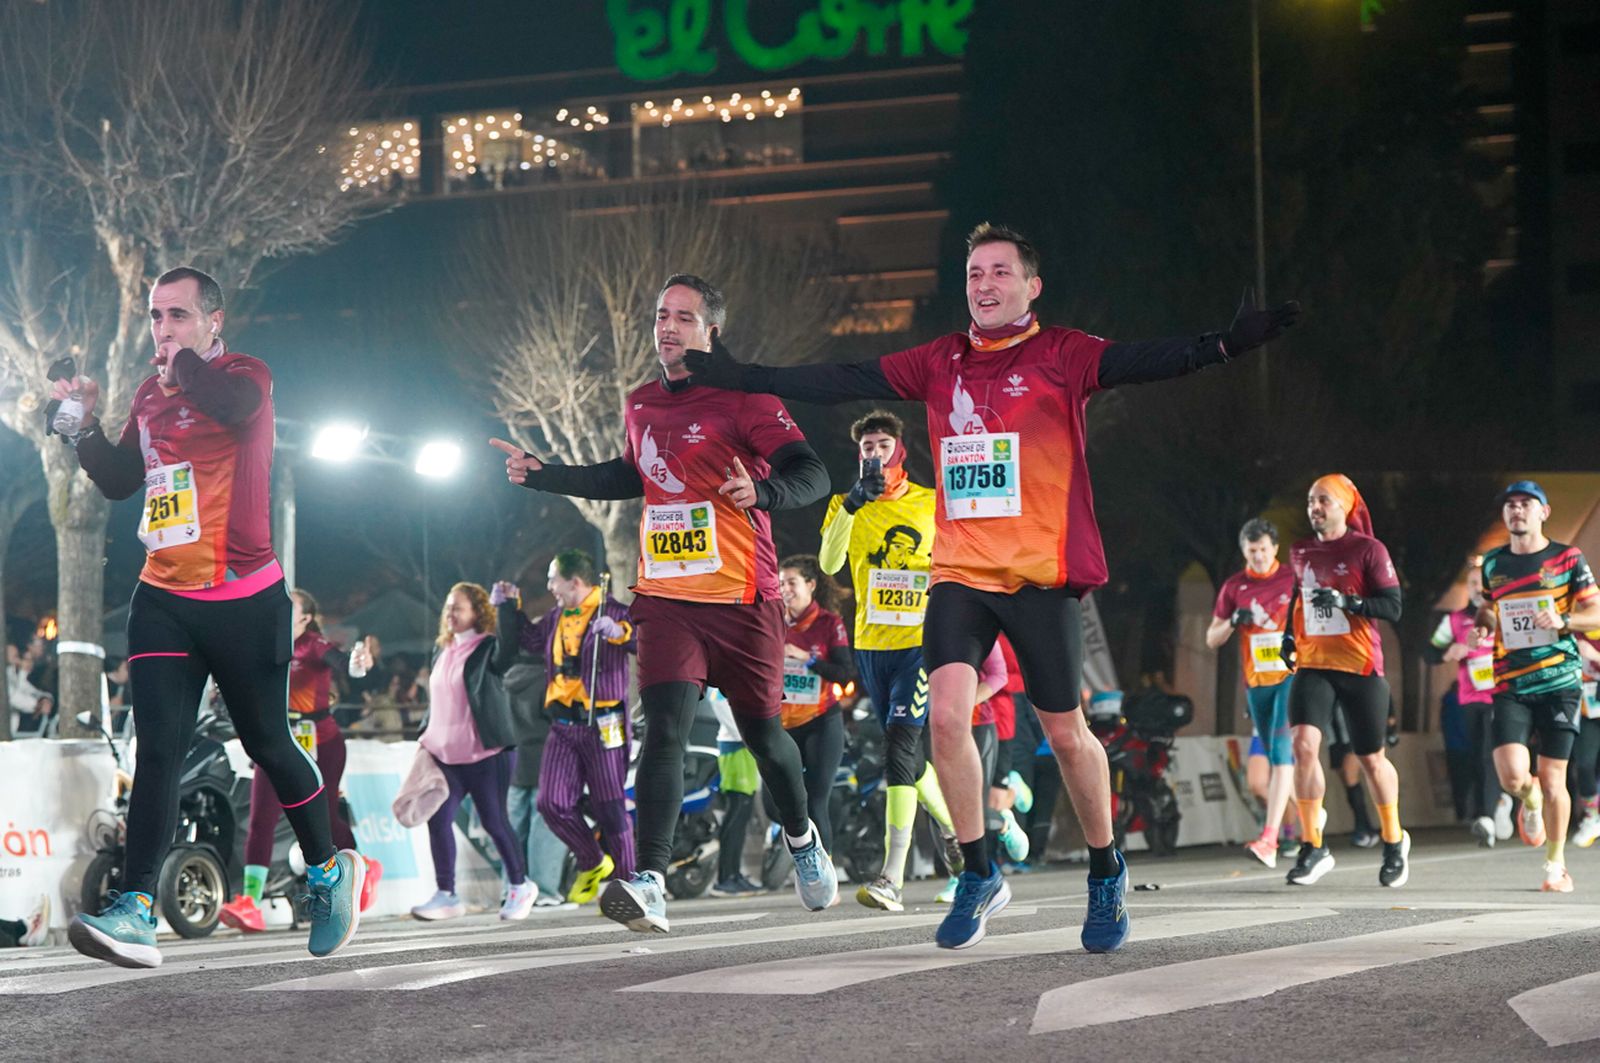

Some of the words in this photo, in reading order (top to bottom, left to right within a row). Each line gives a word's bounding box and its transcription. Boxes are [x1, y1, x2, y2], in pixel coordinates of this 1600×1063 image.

[953, 443, 974, 453] NOCHE
[976, 443, 985, 452] DE
[651, 463, 667, 483] 43
[948, 463, 1006, 490] 13758
[656, 513, 674, 521] NOCHE
[675, 513, 684, 521] DE
[650, 530, 706, 554] 12843
[877, 589, 922, 607] 12387
[784, 674, 815, 690] 3594
[3, 822, 52, 857] ón
